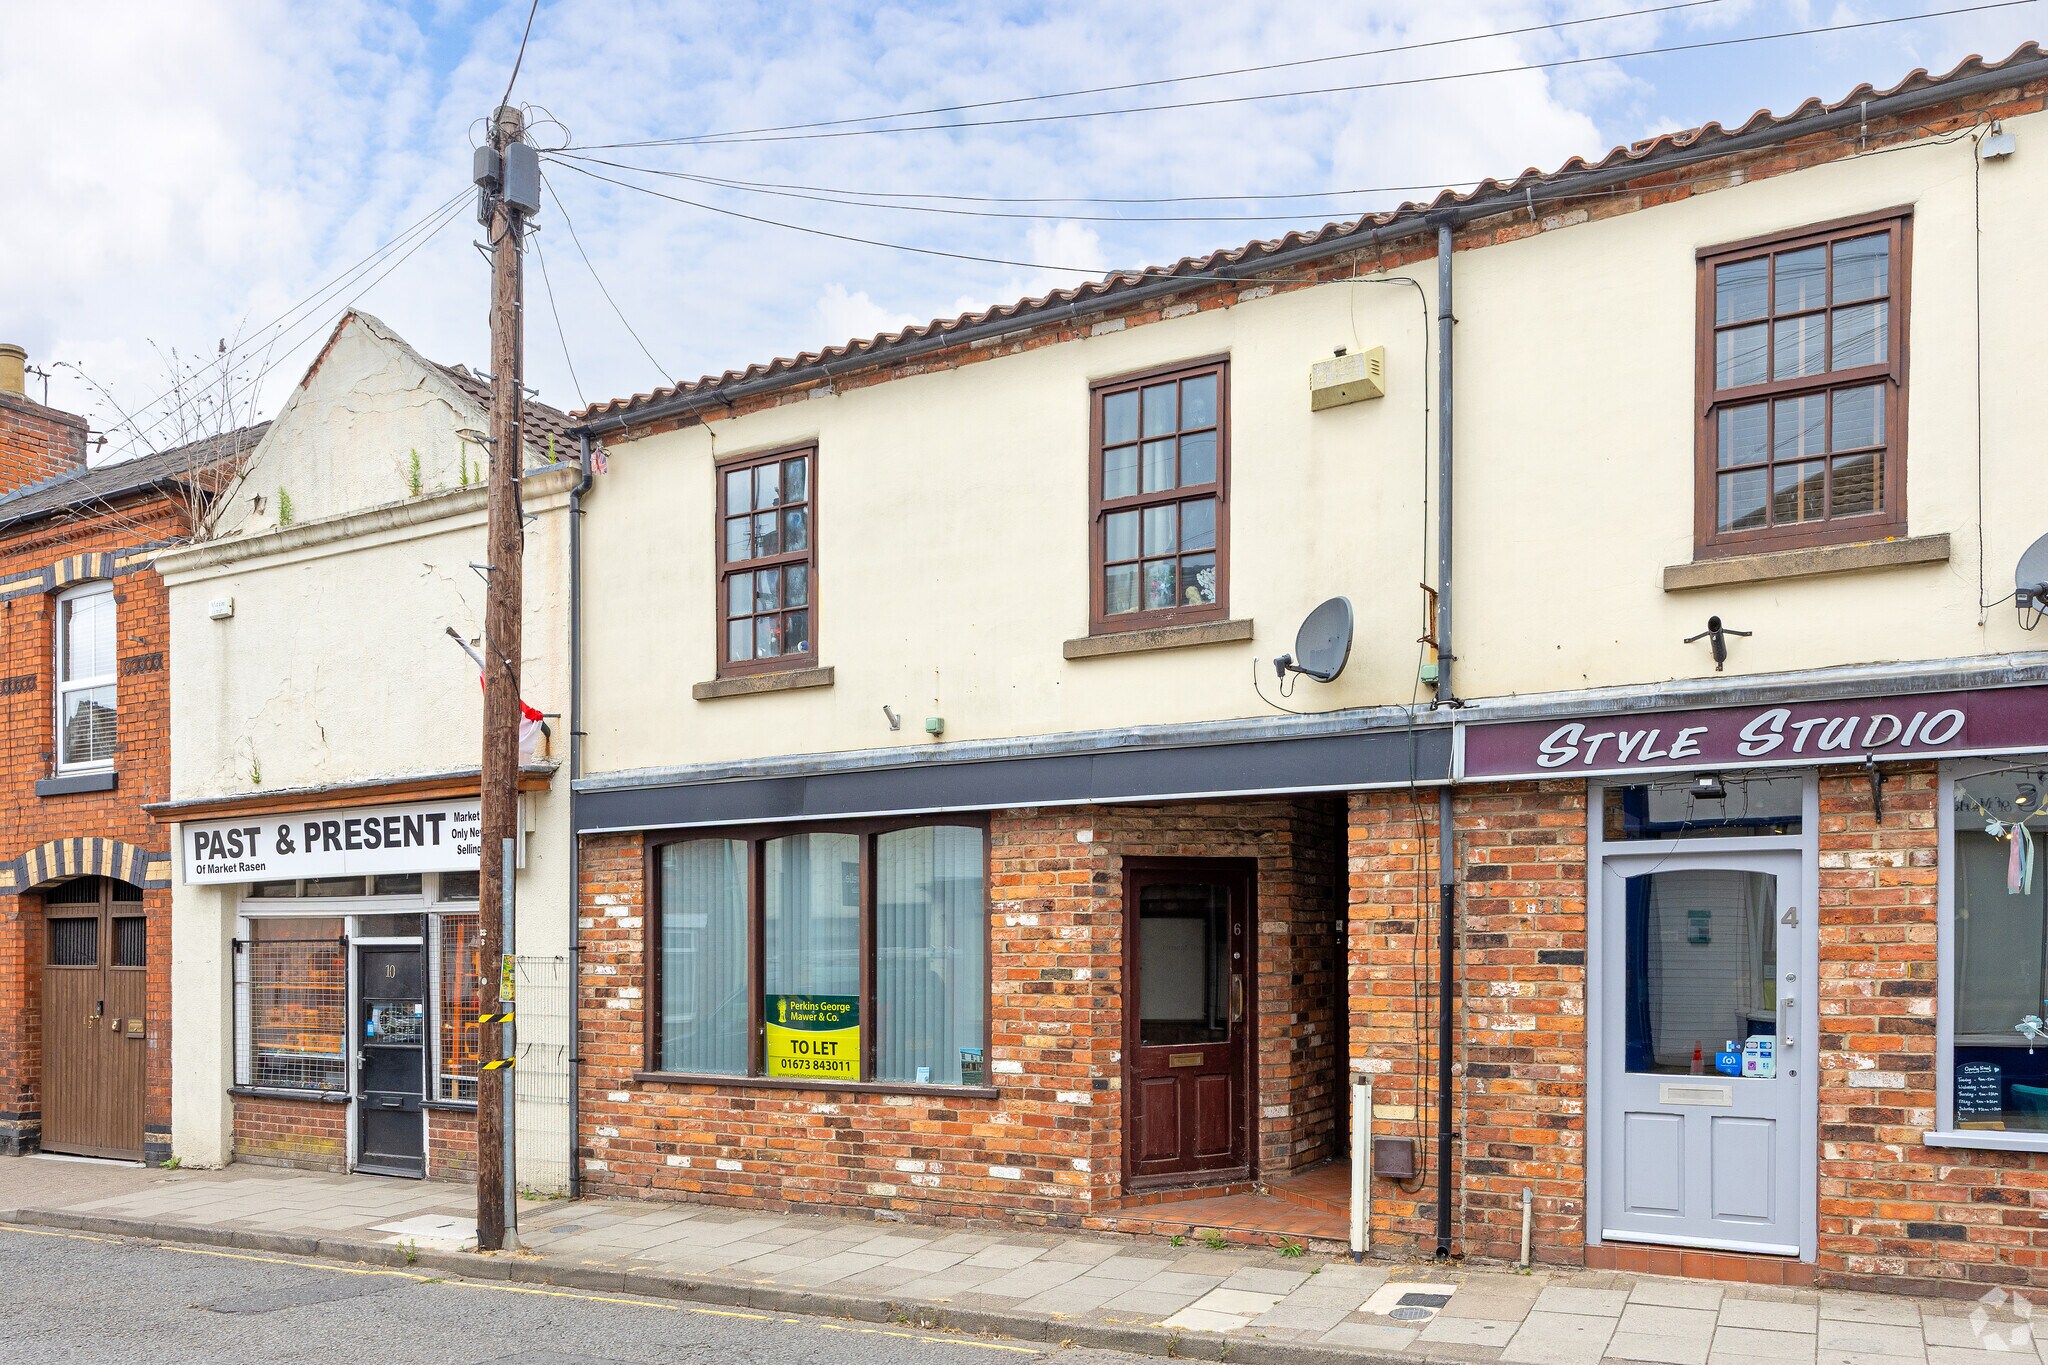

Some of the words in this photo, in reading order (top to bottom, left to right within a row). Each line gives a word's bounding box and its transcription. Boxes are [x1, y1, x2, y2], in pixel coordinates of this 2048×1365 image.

[1537, 722, 1708, 768] STYLE
[1737, 708, 1965, 757] STUDIO
[454, 811, 480, 822] Market
[194, 827, 261, 860] PAST
[276, 824, 296, 855] &
[304, 812, 446, 853] PRESENT
[451, 828, 468, 841] Only
[470, 827, 482, 838] Ne
[457, 843, 481, 856] Selling
[196, 864, 206, 874] Of
[207, 863, 237, 874] Market
[239, 862, 266, 872] Rasen
[1781, 906, 1799, 928] 4
[1234, 923, 1241, 936] 6
[385, 964, 396, 978] 10
[790, 1001, 819, 1010] Perkins
[820, 1002, 850, 1013] George
[790, 1012, 817, 1021] Mawer
[818, 1013, 825, 1021] &
[826, 1013, 839, 1021] Co.
[790, 1040, 809, 1054] TO
[813, 1041, 838, 1055] LET
[781, 1058, 810, 1070] 01673
[813, 1060, 850, 1071] 843011
